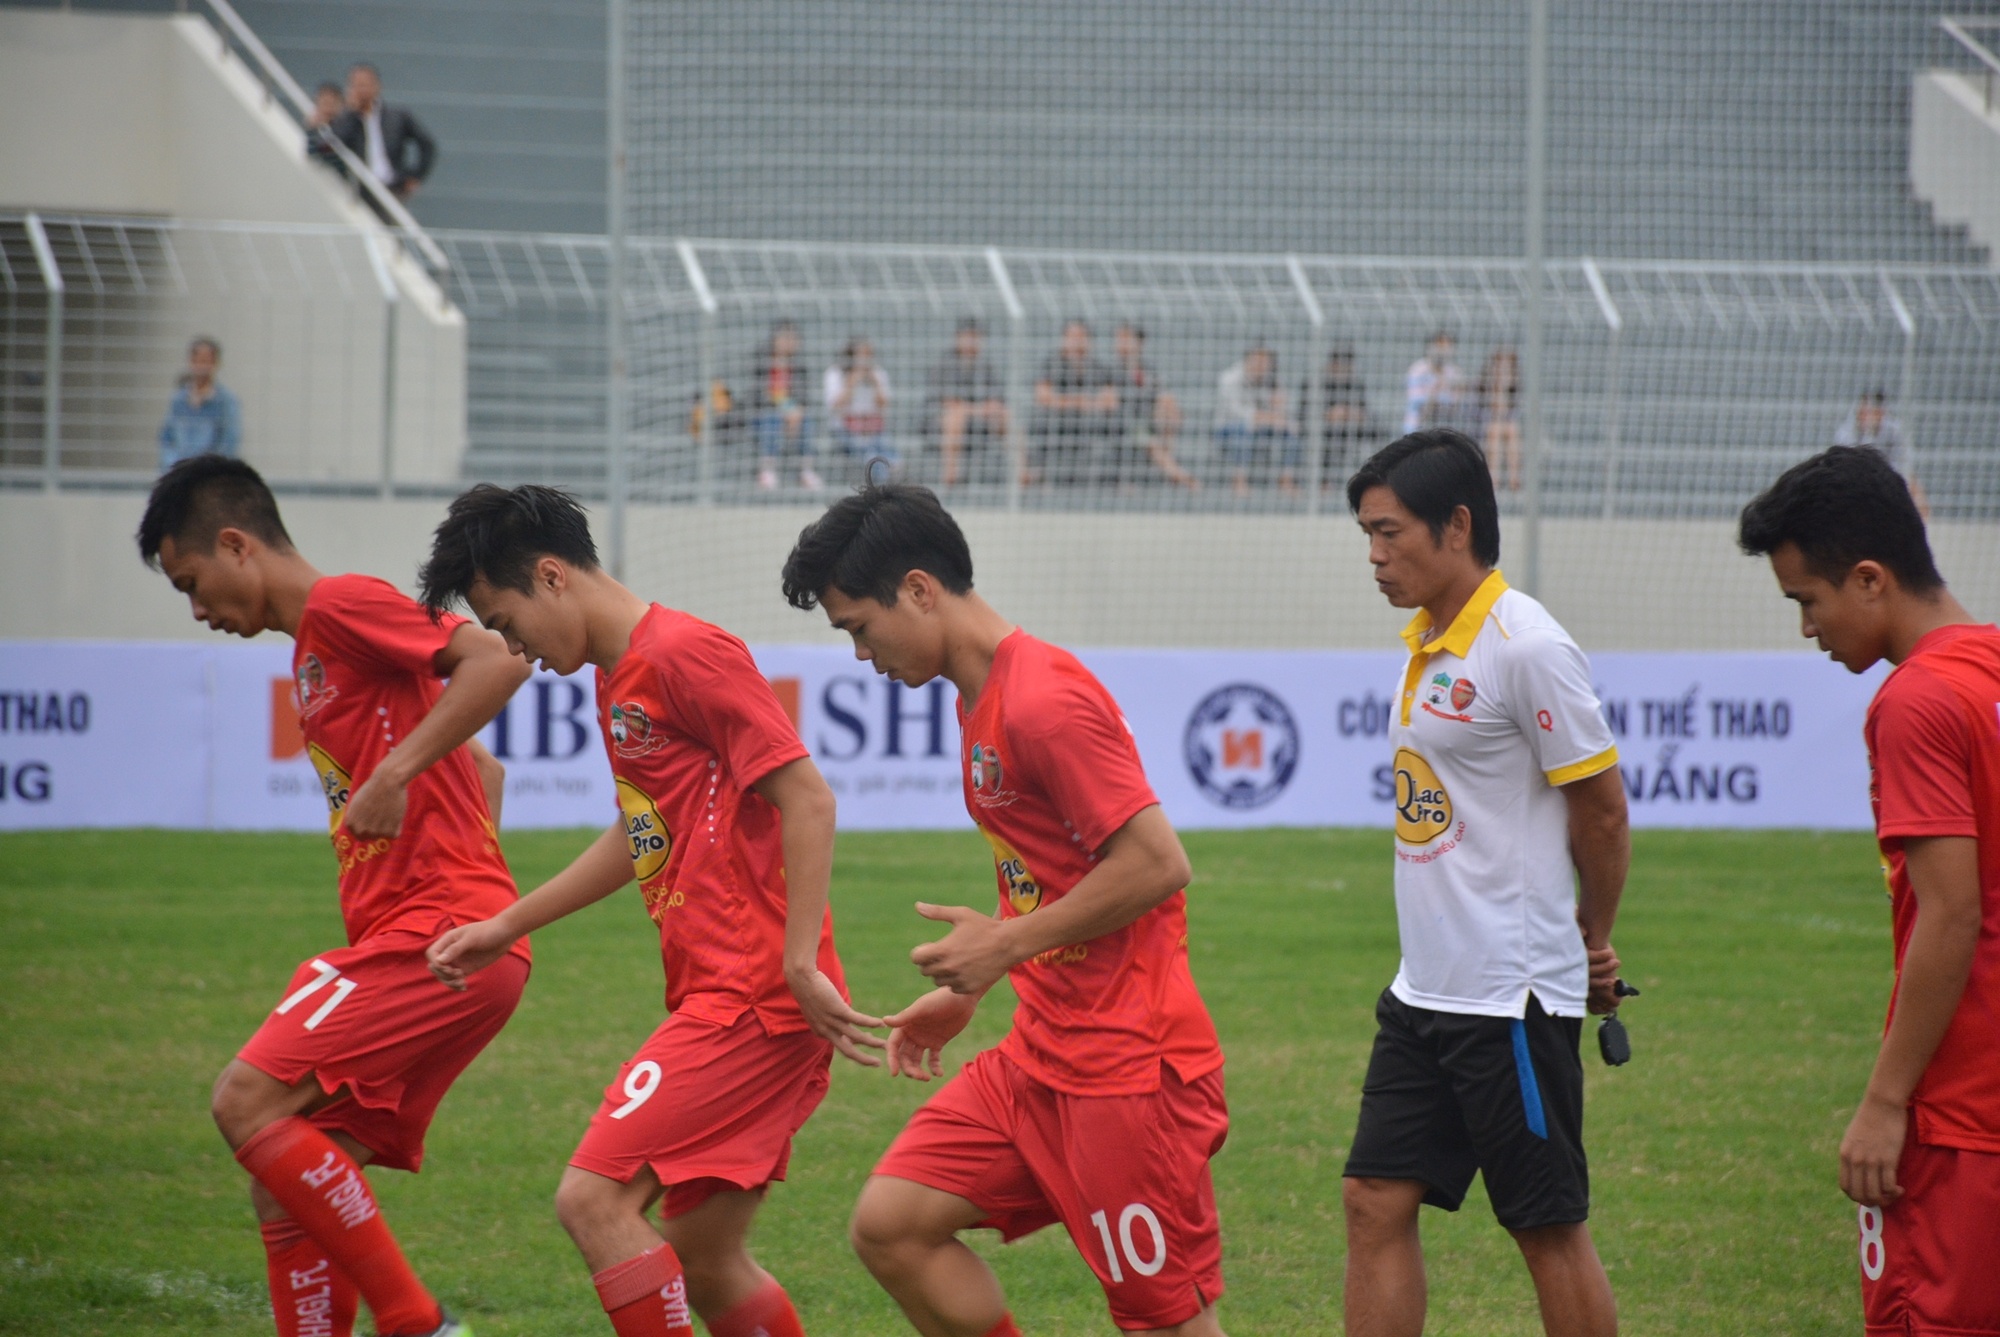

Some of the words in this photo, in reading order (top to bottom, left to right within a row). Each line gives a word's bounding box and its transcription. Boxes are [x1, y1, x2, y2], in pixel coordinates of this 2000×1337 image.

[0, 690, 91, 734] THAO
[816, 675, 950, 762] SH
[1537, 709, 1553, 732] Q
[1708, 699, 1792, 739] THAO
[275, 958, 358, 1031] 71
[609, 1060, 662, 1120] 9
[300, 1151, 346, 1189] FC
[1090, 1202, 1167, 1284] 10
[1859, 1204, 1886, 1281] 8
[289, 1259, 331, 1290] FC
[295, 1284, 332, 1337] HAGL
